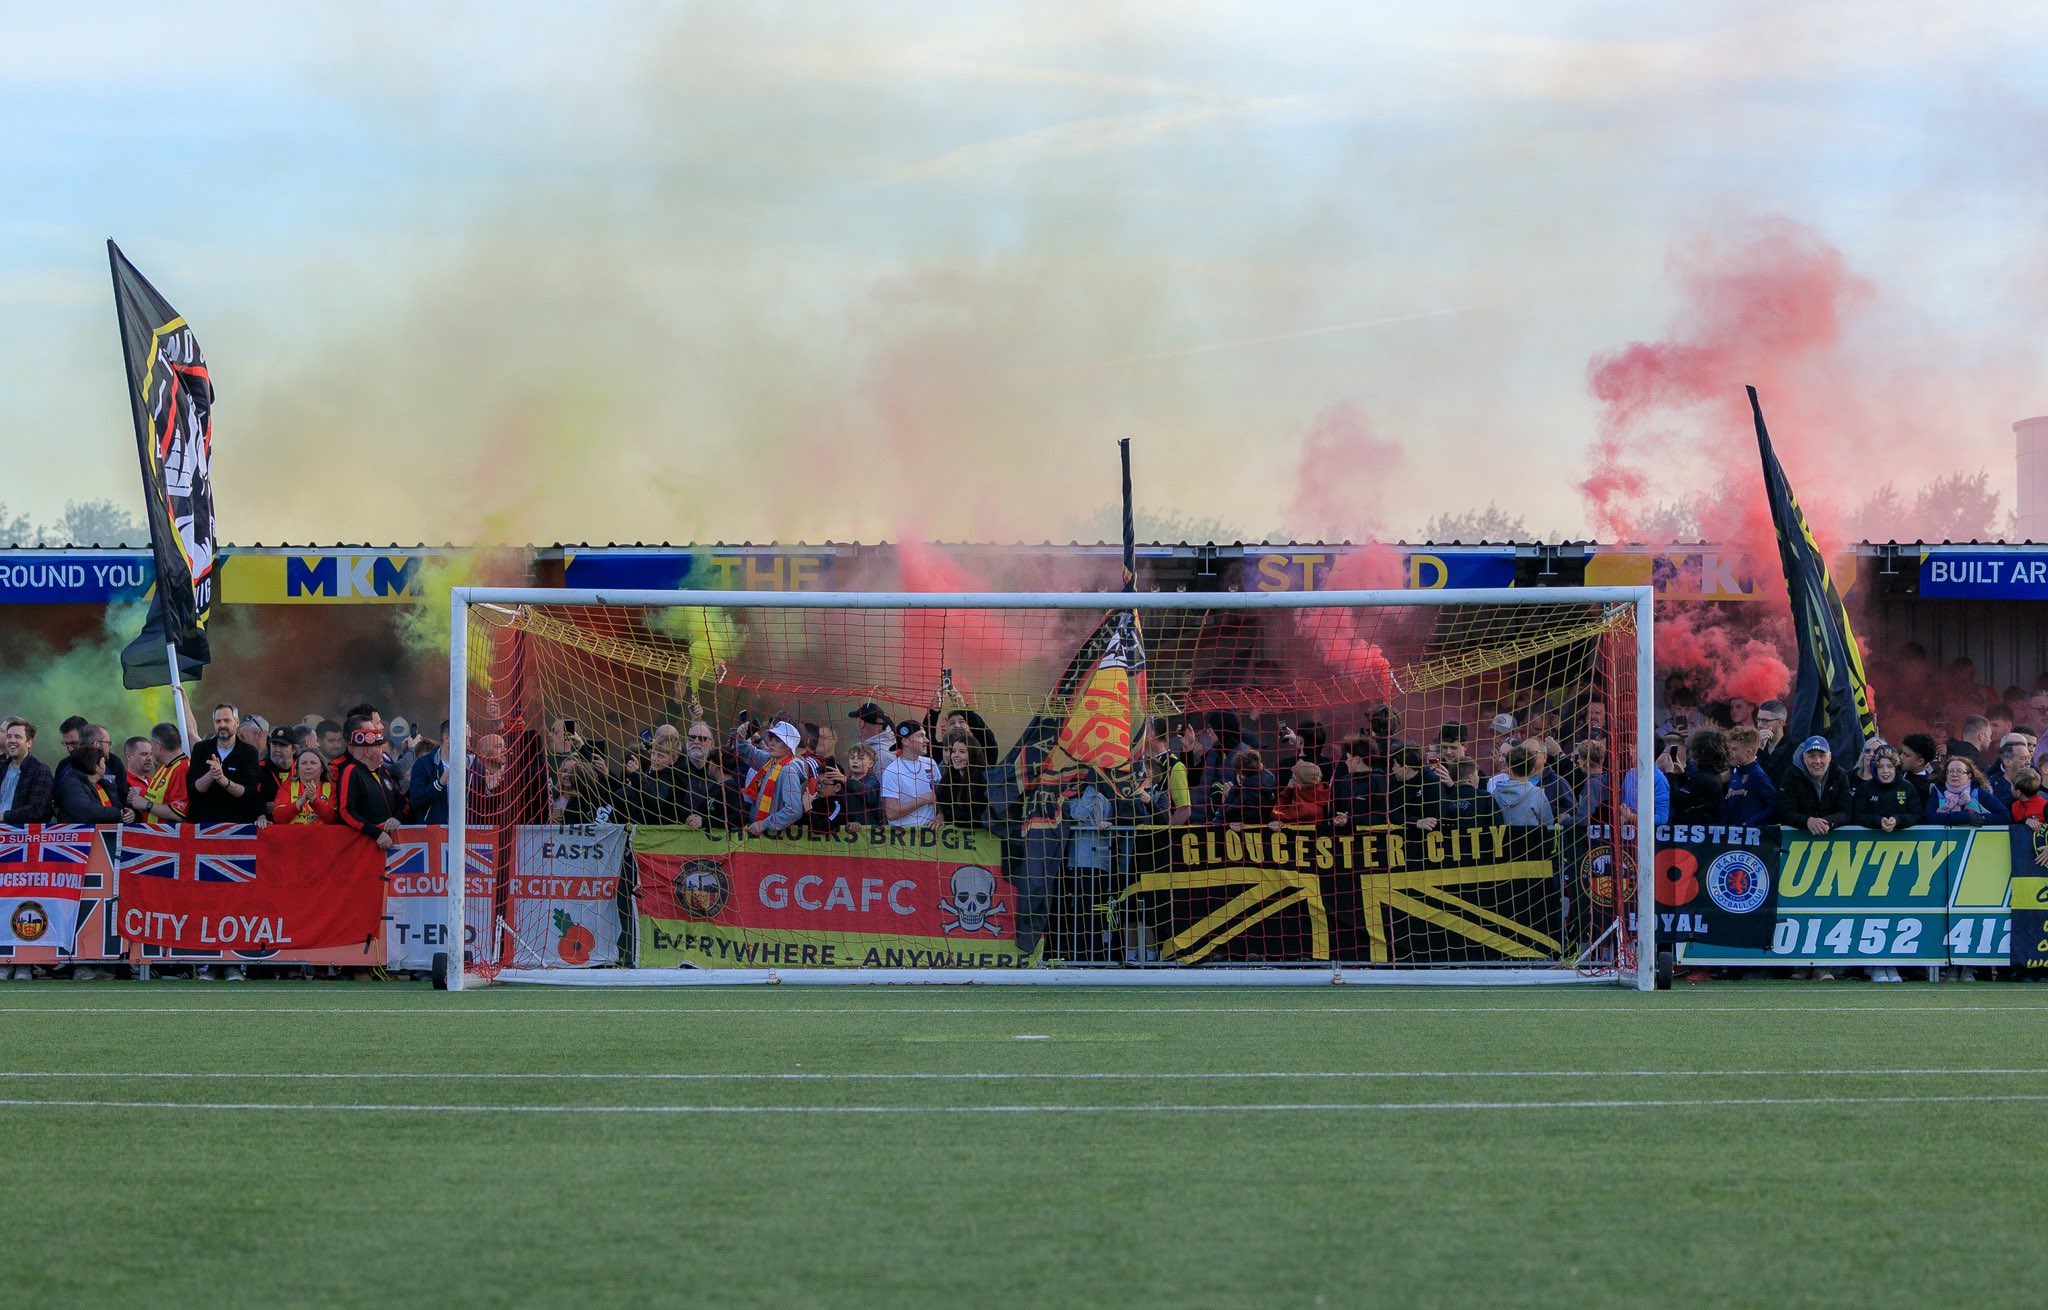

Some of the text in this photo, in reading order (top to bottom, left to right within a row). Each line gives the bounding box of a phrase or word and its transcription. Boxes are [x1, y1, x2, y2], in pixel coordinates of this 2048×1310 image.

[93, 565, 144, 587] YOU
[287, 557, 425, 596] MKM
[712, 556, 820, 591] THE
[1258, 554, 1448, 592] STD
[1653, 554, 1772, 593] MK
[1931, 561, 2047, 583] BUILT AR
[9, 833, 79, 844] SURRENDER
[559, 825, 597, 836] THE
[870, 825, 976, 851] BRIDGE
[1587, 824, 1762, 846] GOCESTER
[543, 842, 604, 860] EASTS
[1182, 825, 1506, 869] GLOUCESTER CITY
[1716, 855, 1762, 873] RANGERS
[1778, 841, 1957, 898] UNTY
[393, 876, 614, 897] GLOUESTR CITY AFC
[759, 874, 917, 915] GCAFC
[1712, 886, 1763, 909] FOOTBALL CLUB
[125, 908, 292, 944] CITY LOYAL
[1628, 912, 1708, 934] LYAL
[653, 928, 835, 966] EVERYWHERE
[862, 947, 1030, 969] ANYWHERE
[1771, 918, 1923, 955] 01452
